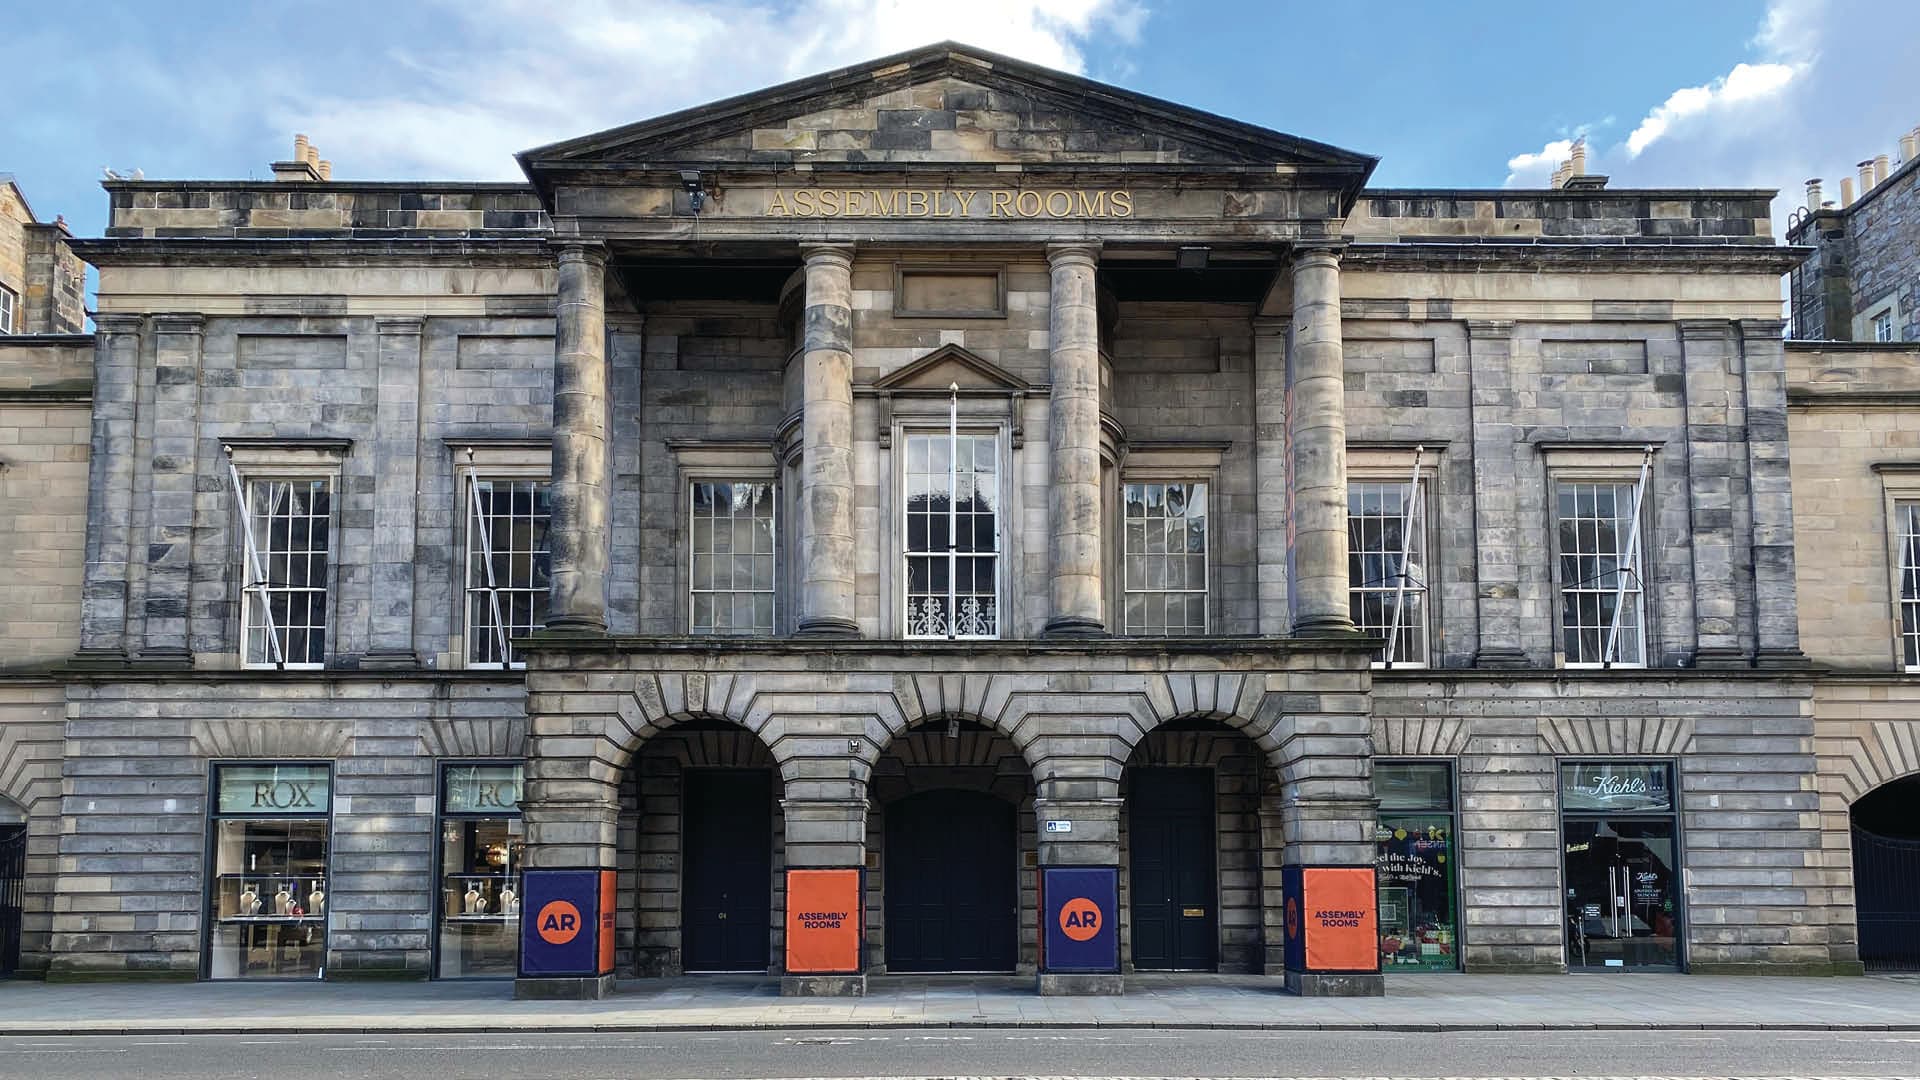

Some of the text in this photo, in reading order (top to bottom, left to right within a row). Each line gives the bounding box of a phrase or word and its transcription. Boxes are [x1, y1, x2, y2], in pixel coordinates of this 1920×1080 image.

[766, 190, 1133, 217] ASSEMBLY ROOMS
[1589, 776, 1647, 795] Kiehl's
[251, 781, 316, 808] ROX
[475, 781, 522, 808] RO
[1390, 852, 1405, 862] the
[1382, 863, 1404, 873] with
[798, 912, 848, 920] ASSEMBLY
[1065, 911, 1097, 928] AR
[1315, 911, 1366, 919] ASSEMBLY
[543, 913, 576, 931] AR
[804, 921, 840, 929] ROOMS
[1322, 920, 1359, 928] ROOMS
